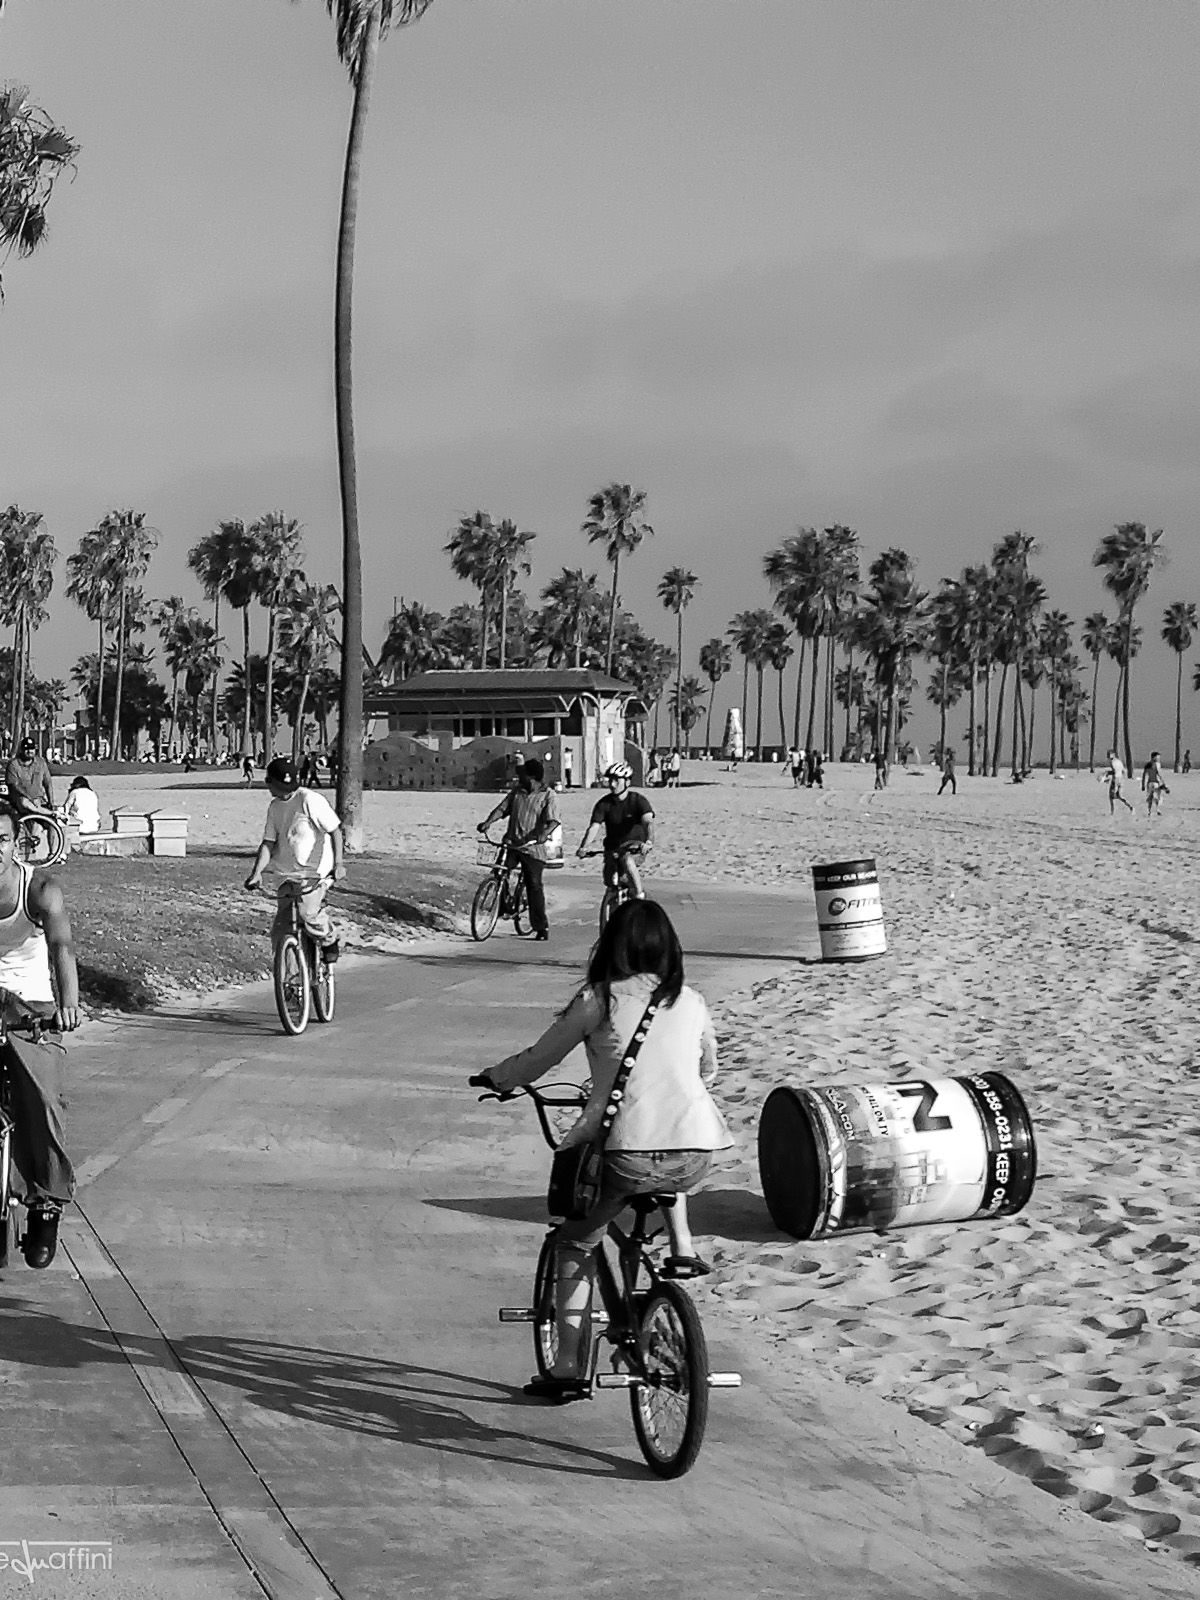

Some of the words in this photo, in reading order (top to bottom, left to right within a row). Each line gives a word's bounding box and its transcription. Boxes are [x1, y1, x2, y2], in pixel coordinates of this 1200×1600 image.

[874, 1110, 885, 1122] ON
[982, 1090, 1014, 1151] 358-0231
[995, 1153, 1010, 1184] KEEP
